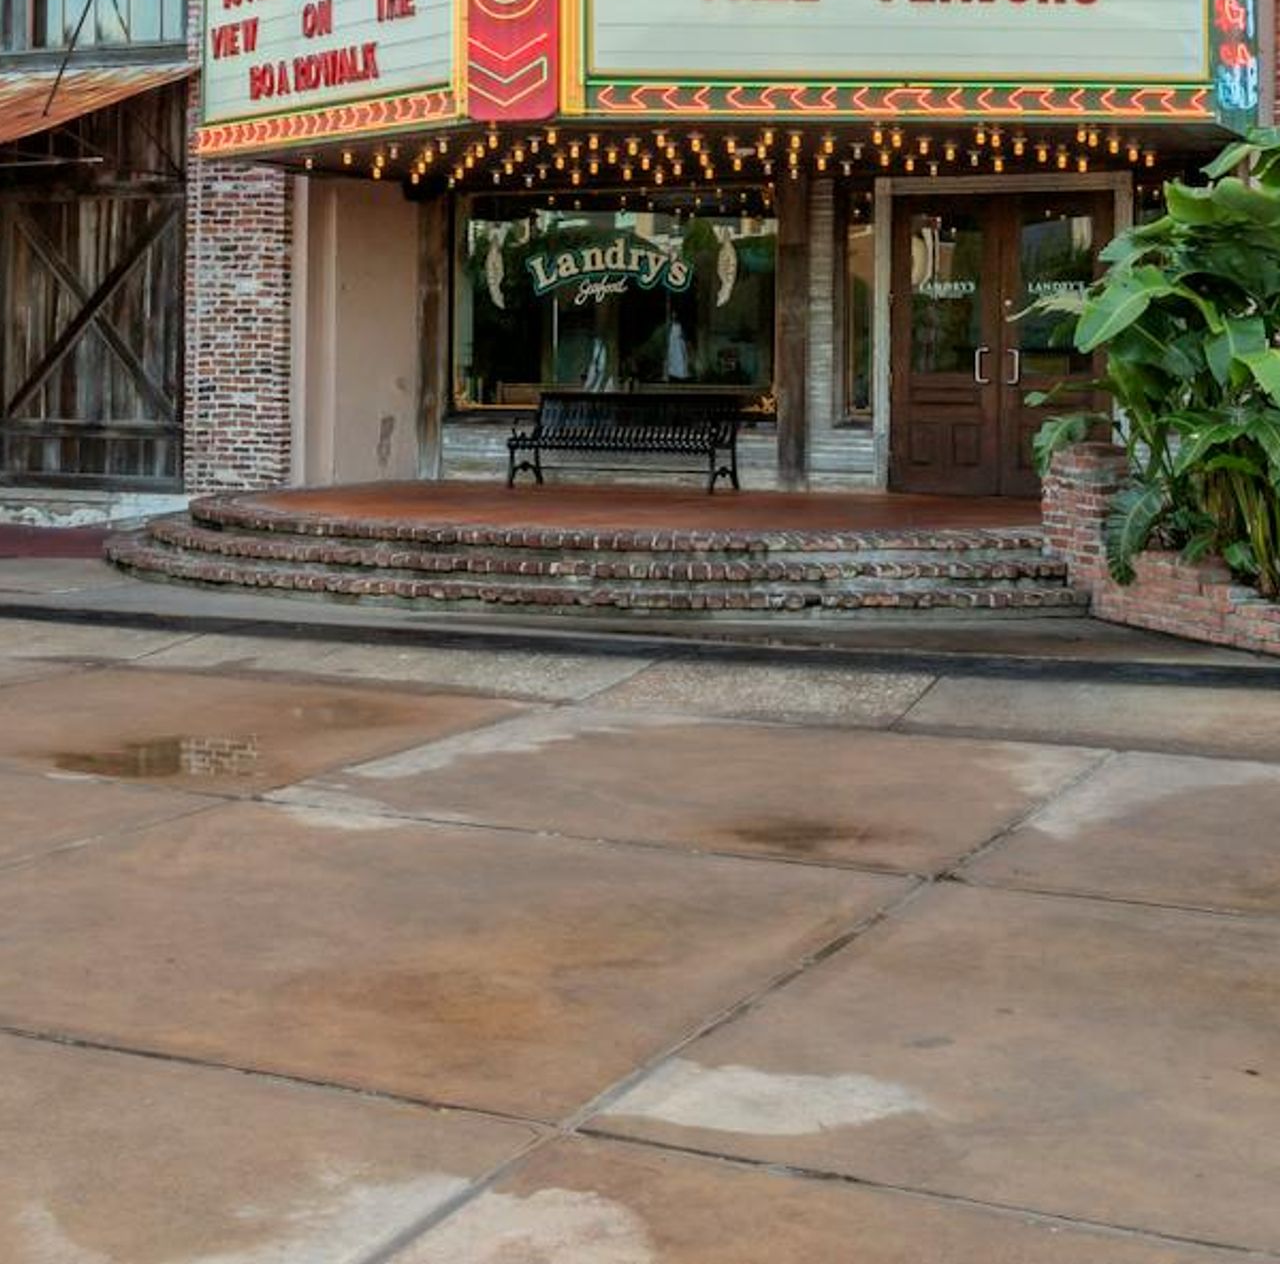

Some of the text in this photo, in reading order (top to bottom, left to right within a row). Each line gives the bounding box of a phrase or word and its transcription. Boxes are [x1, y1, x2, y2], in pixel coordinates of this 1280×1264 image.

[211, 17, 259, 60] VIEW
[302, 0, 333, 39] ON
[249, 42, 381, 102] BOARDWALK
[529, 238, 689, 289] Landry's
